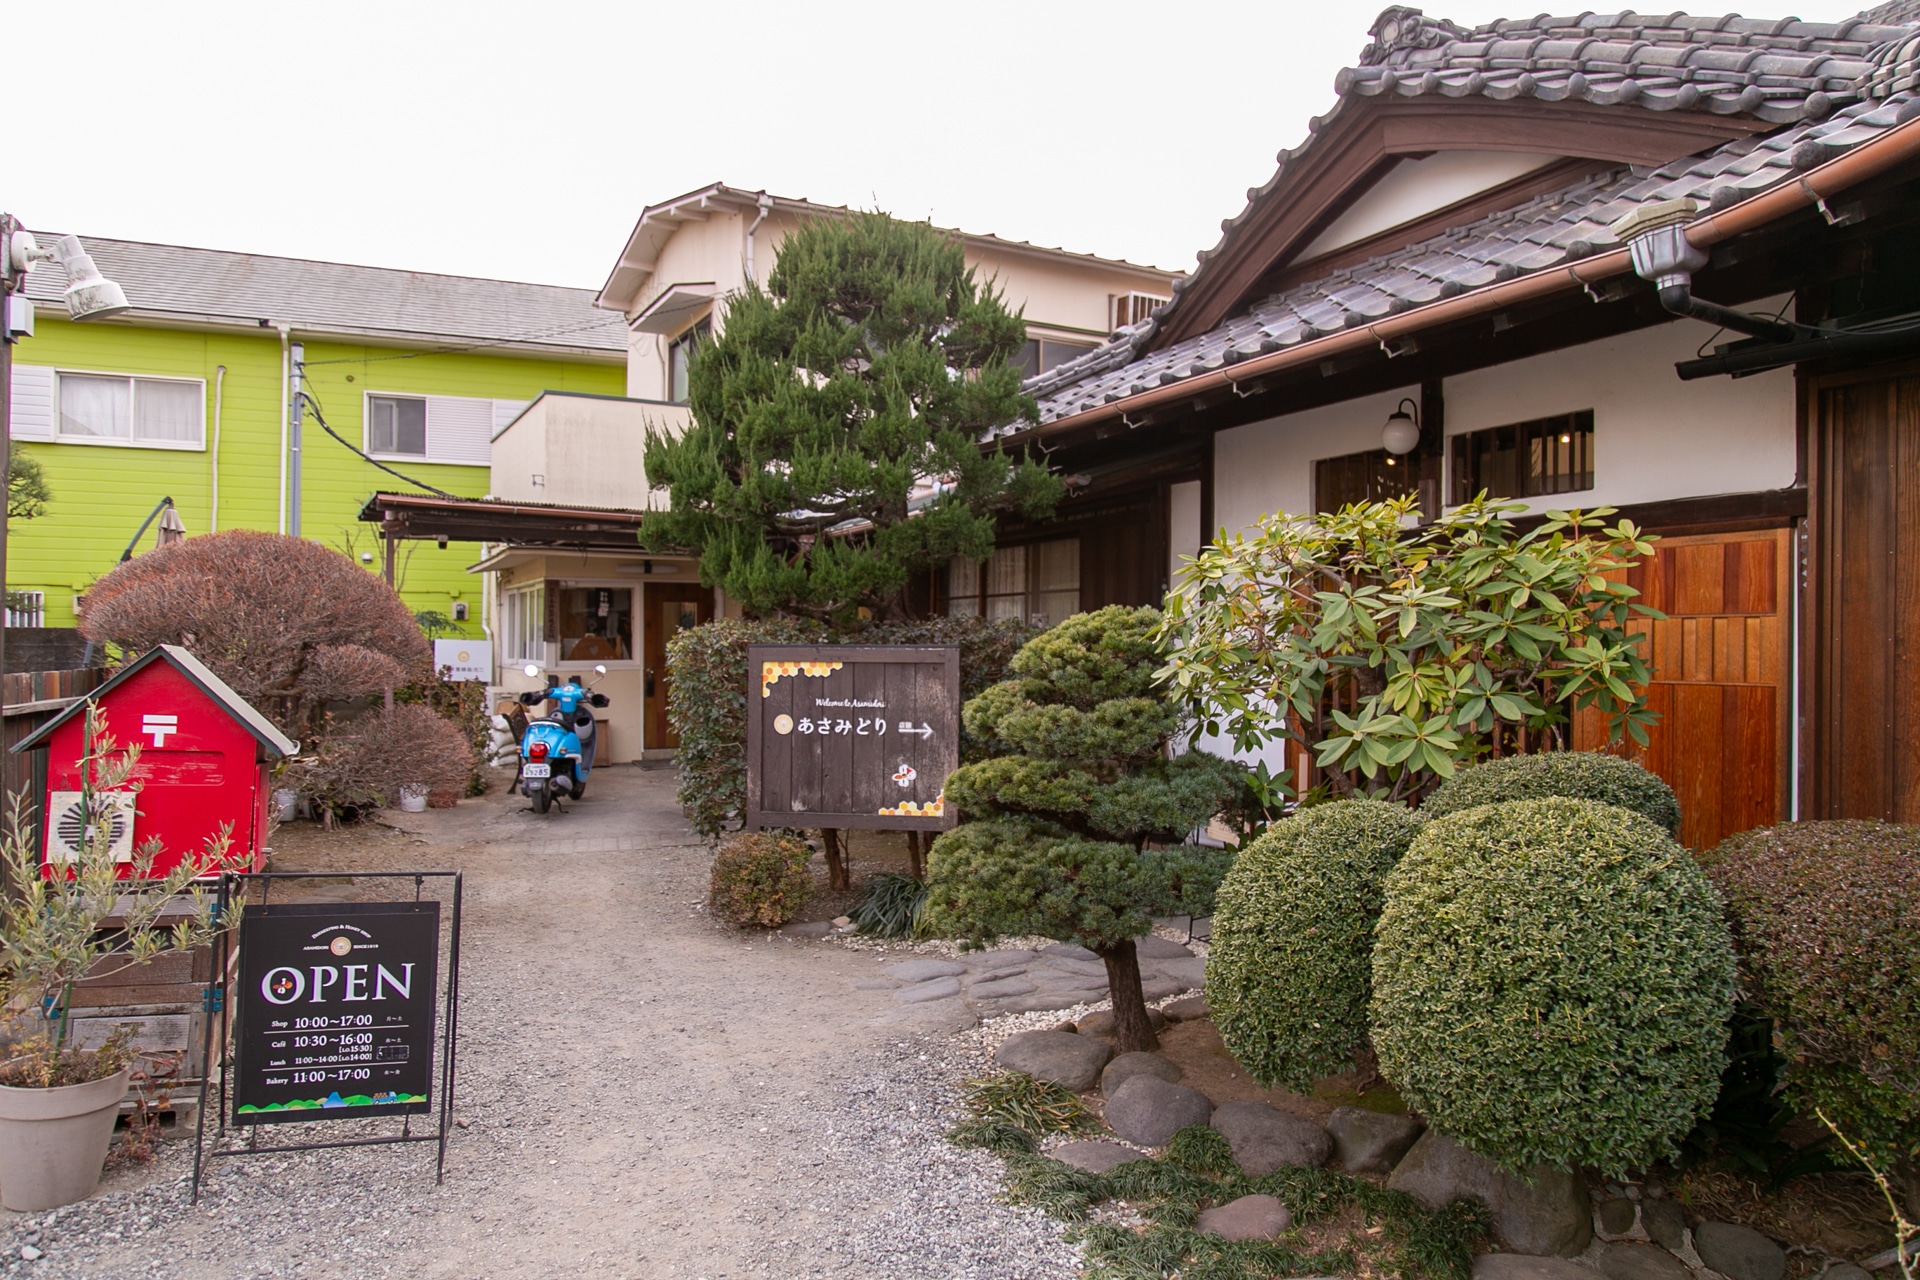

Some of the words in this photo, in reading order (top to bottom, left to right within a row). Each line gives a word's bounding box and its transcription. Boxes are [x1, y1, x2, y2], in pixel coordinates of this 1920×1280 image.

[797, 717, 887, 735] あさみどり
[260, 963, 416, 1005] OPEN
[271, 1020, 289, 1029] Shop
